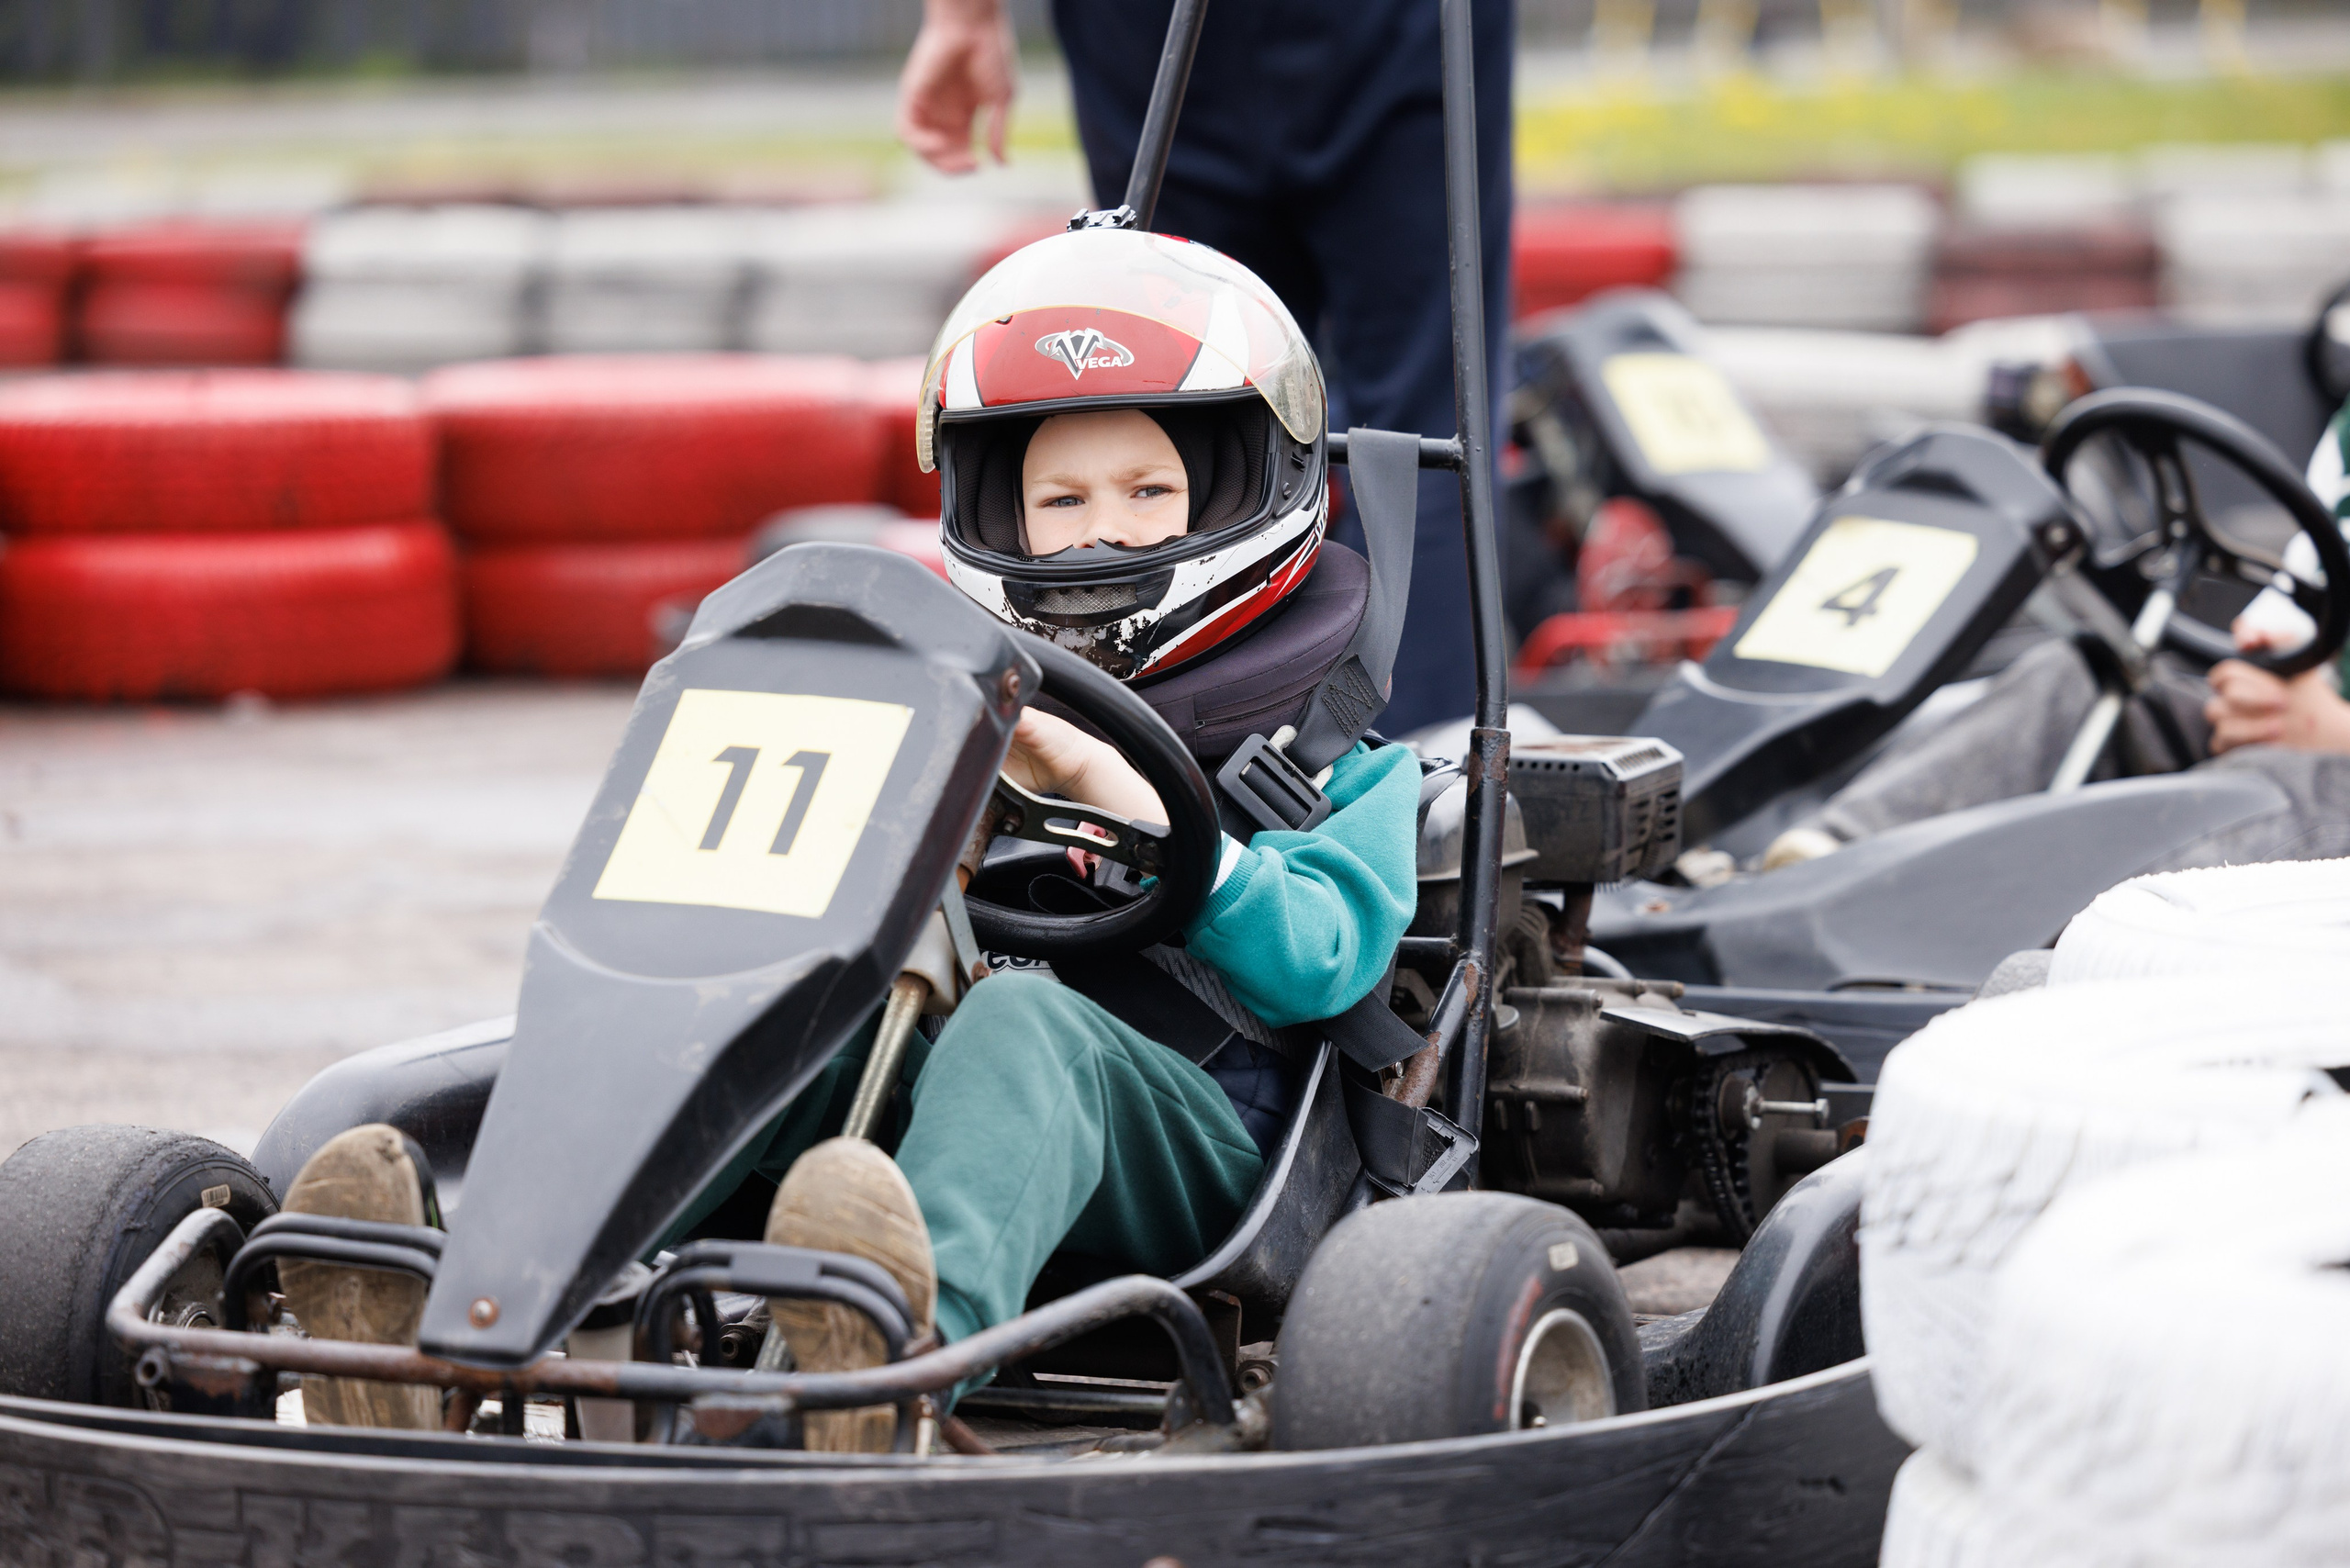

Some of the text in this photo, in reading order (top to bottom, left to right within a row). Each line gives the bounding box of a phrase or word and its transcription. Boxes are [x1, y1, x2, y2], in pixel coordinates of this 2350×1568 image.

[1077, 356, 1123, 370] VEGA
[1821, 566, 1899, 626] 4
[698, 745, 832, 857] 11
